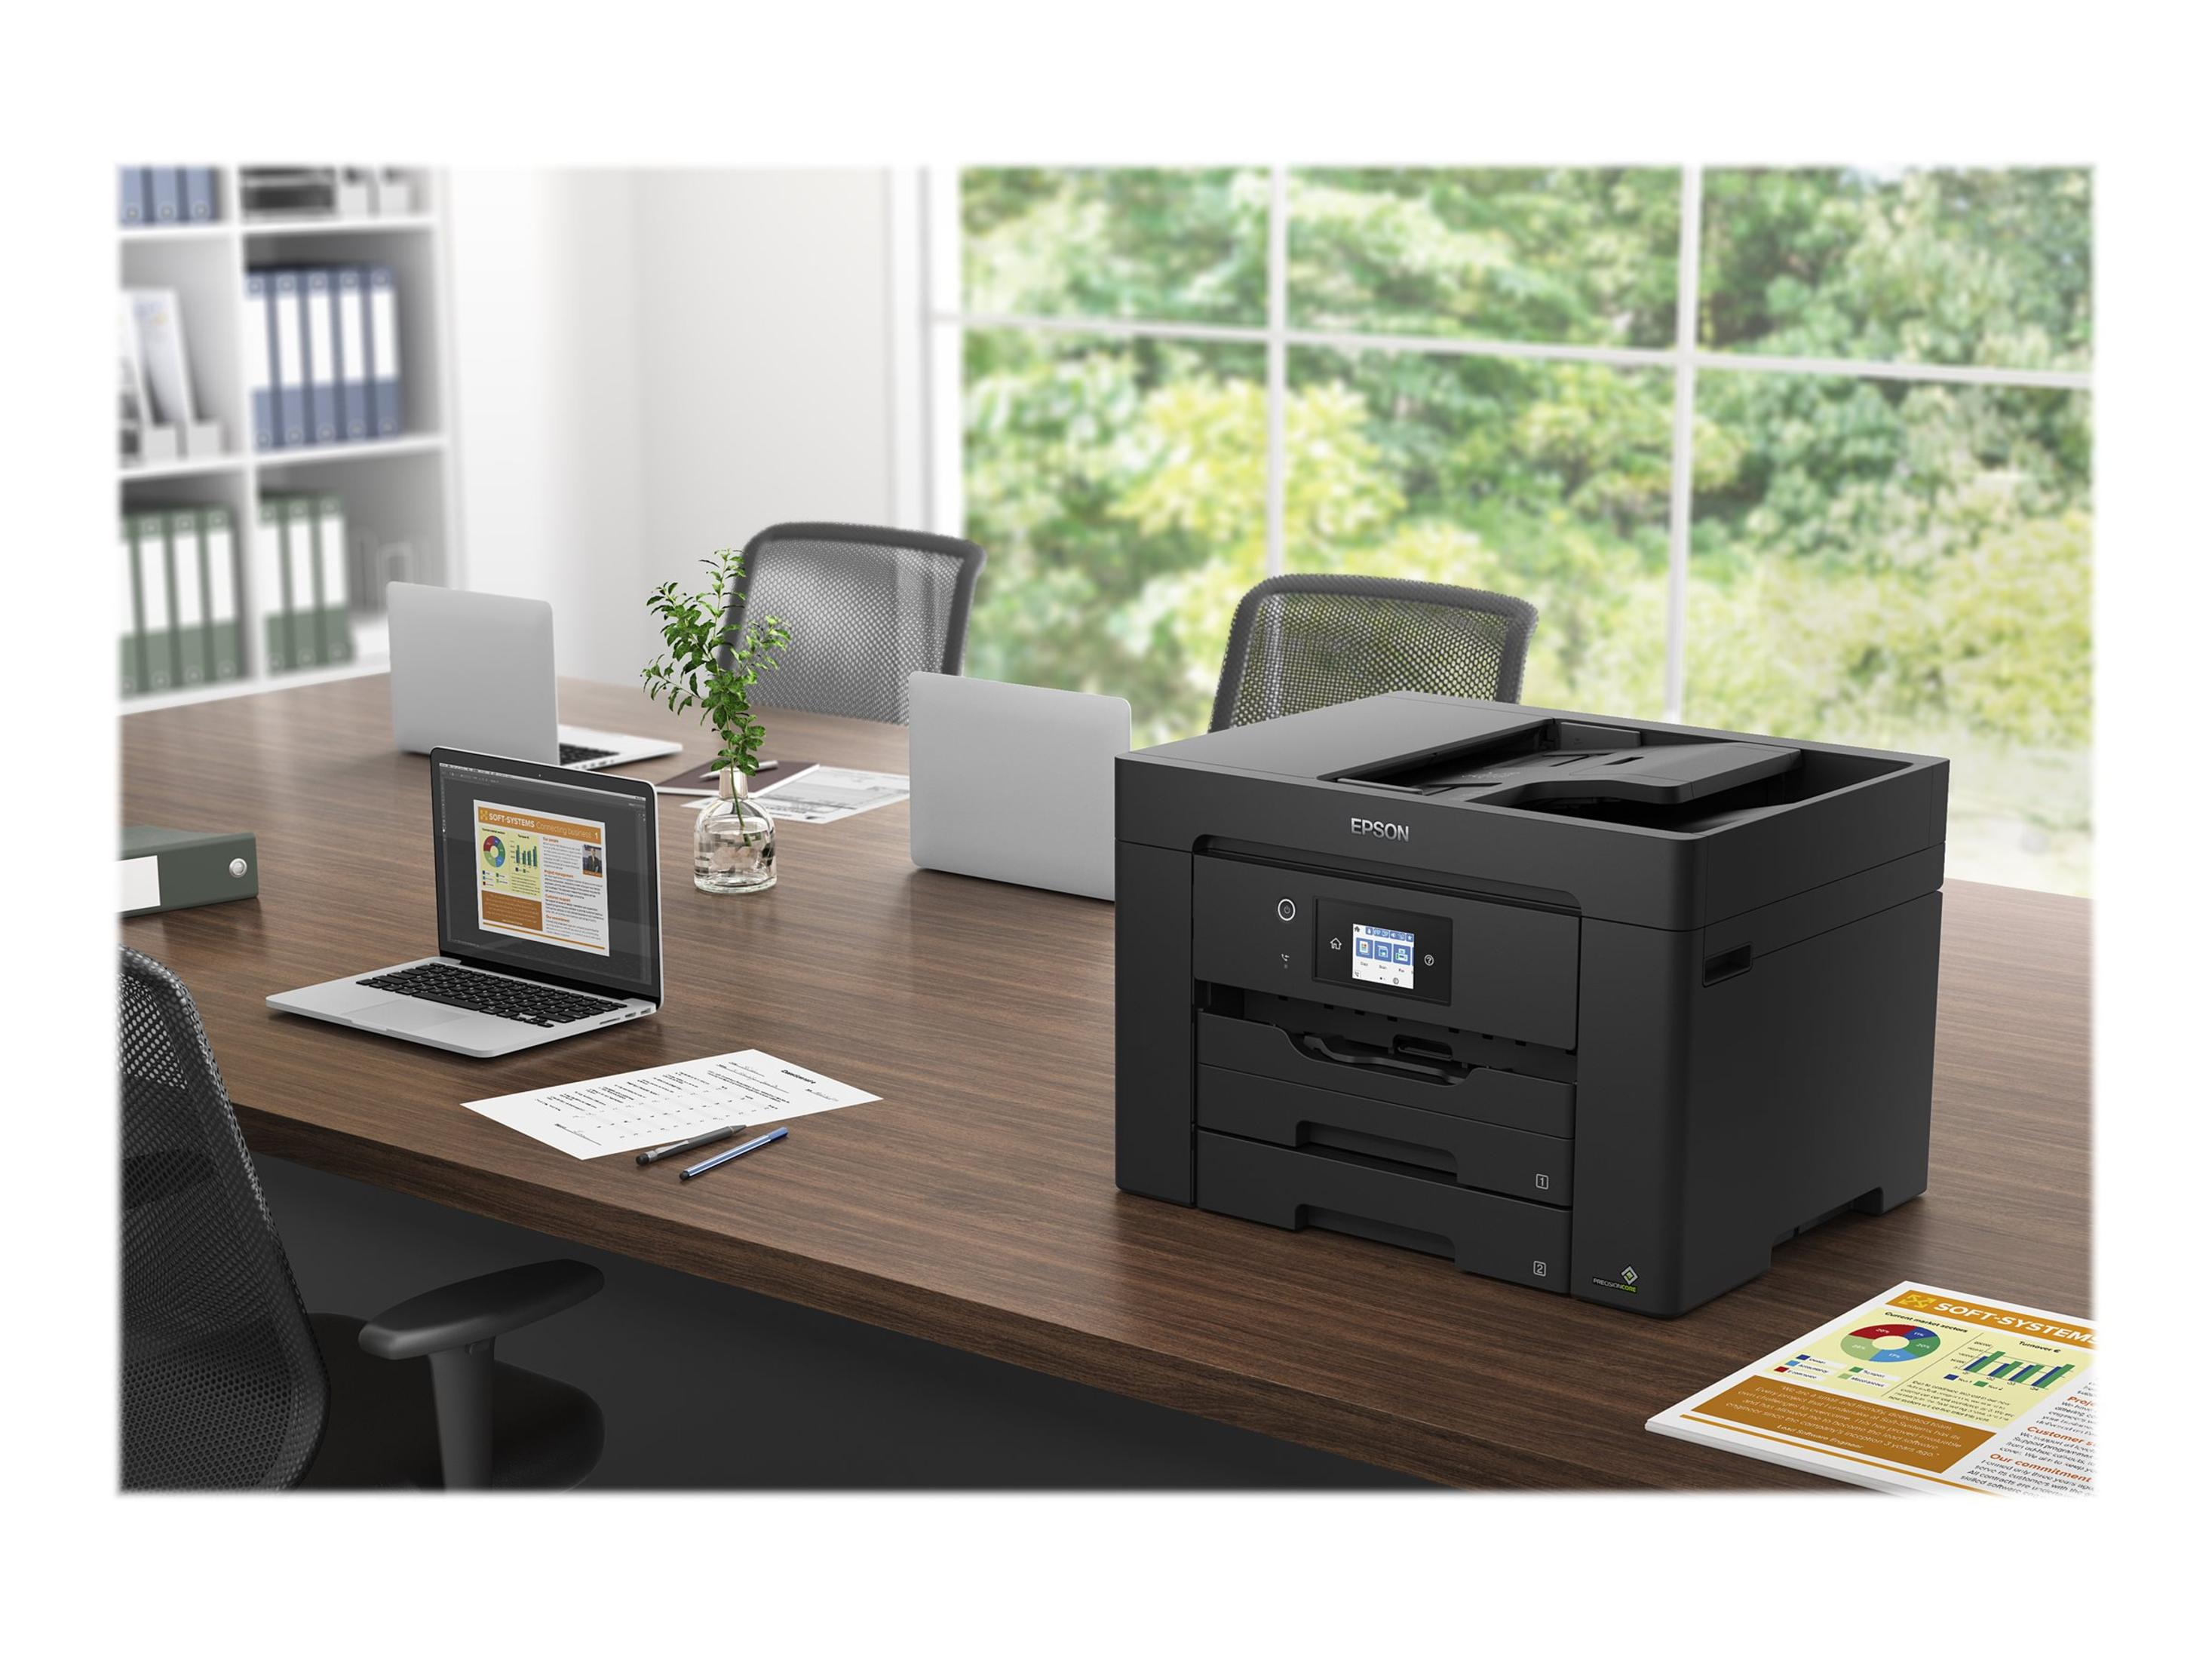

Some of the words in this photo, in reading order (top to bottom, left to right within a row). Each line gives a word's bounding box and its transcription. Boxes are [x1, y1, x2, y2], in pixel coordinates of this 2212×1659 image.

[489, 814, 535, 827] SOFT-SYSTEMS
[1351, 817, 1409, 842] EPSON
[2018, 1340, 2053, 1352] Turnover
[2026, 1427, 2086, 1443] Customer
[1989, 1454, 2014, 1462] Our
[2014, 1460, 2094, 1482] commitment
